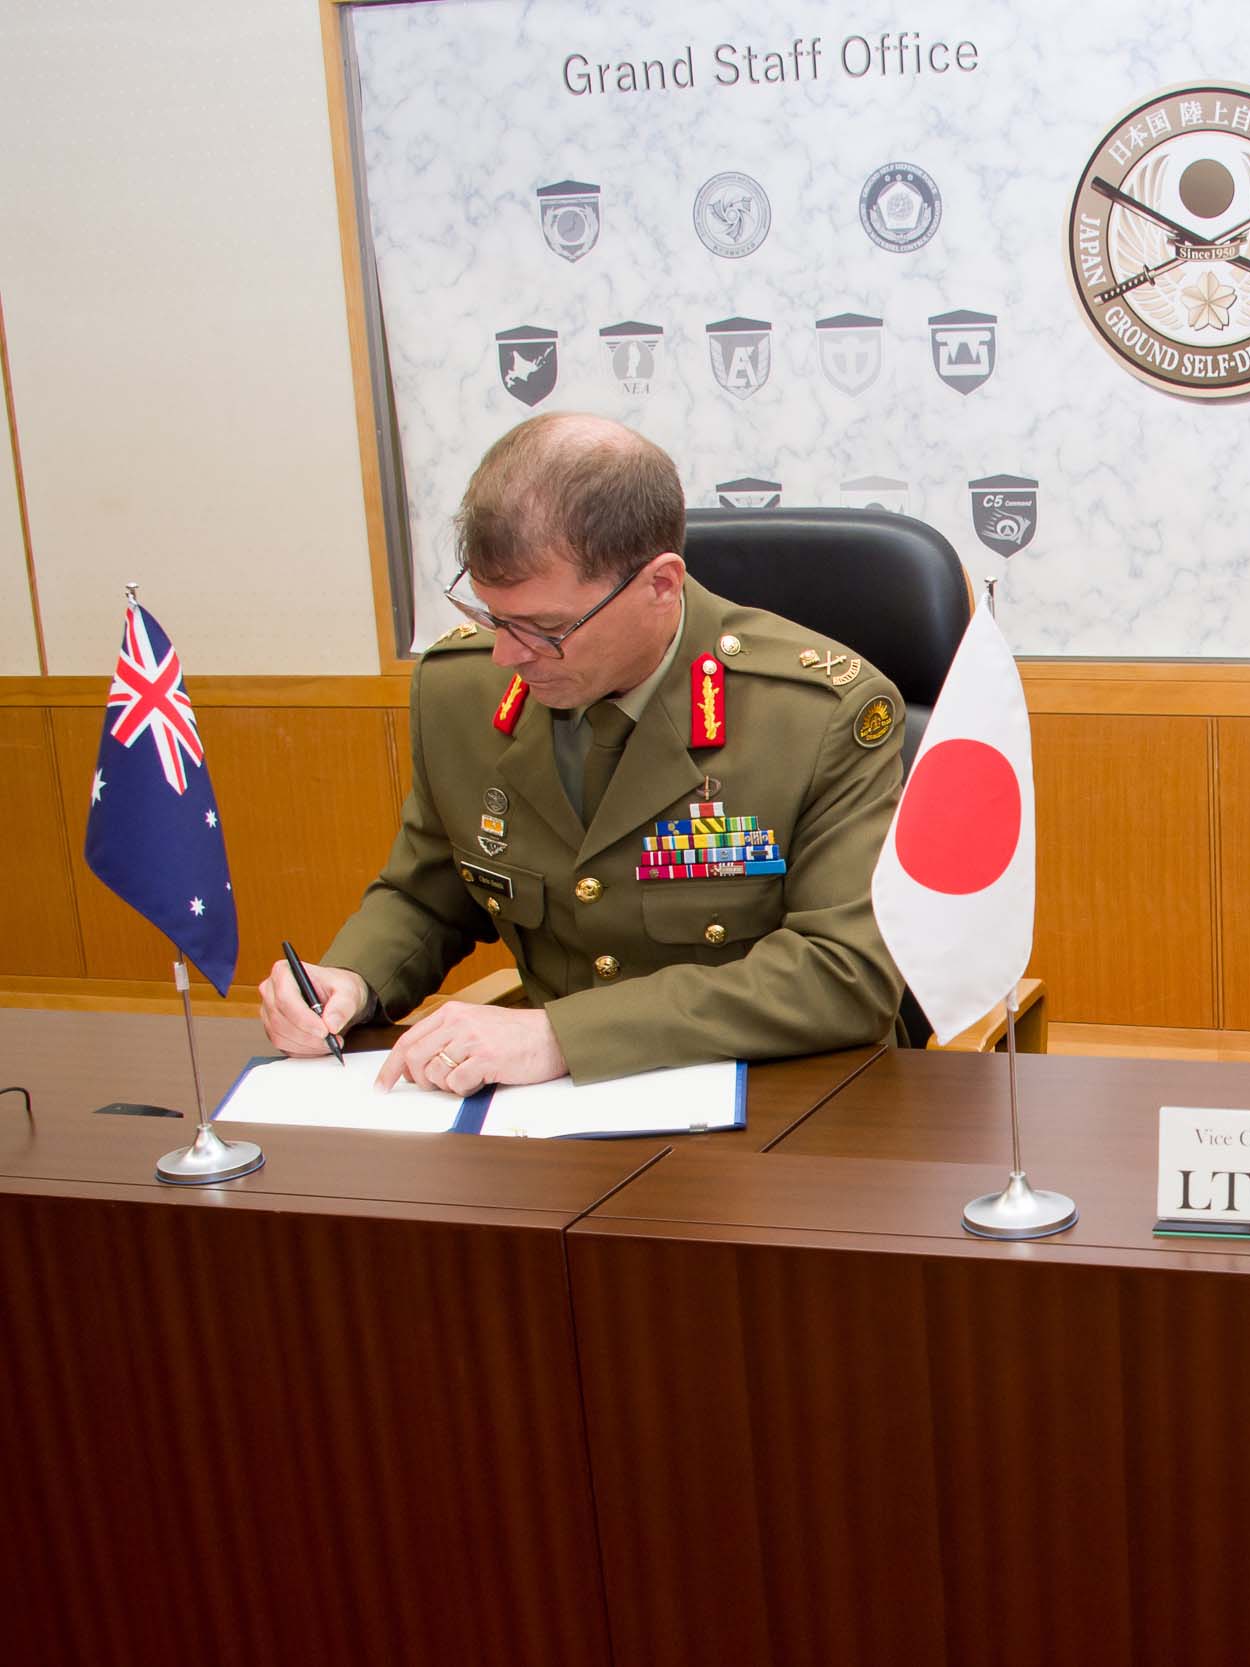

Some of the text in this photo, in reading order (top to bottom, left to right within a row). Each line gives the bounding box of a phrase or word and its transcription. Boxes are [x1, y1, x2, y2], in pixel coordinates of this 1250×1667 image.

[563, 31, 980, 96] Grand Staff Office
[1108, 108, 1173, 167] 日本国
[1078, 213, 1107, 288] JAPAN
[1104, 306, 1180, 371] GROUND
[621, 382, 651, 395] NEA
[983, 495, 1004, 508] C5
[1193, 1128, 1233, 1146] Vice
